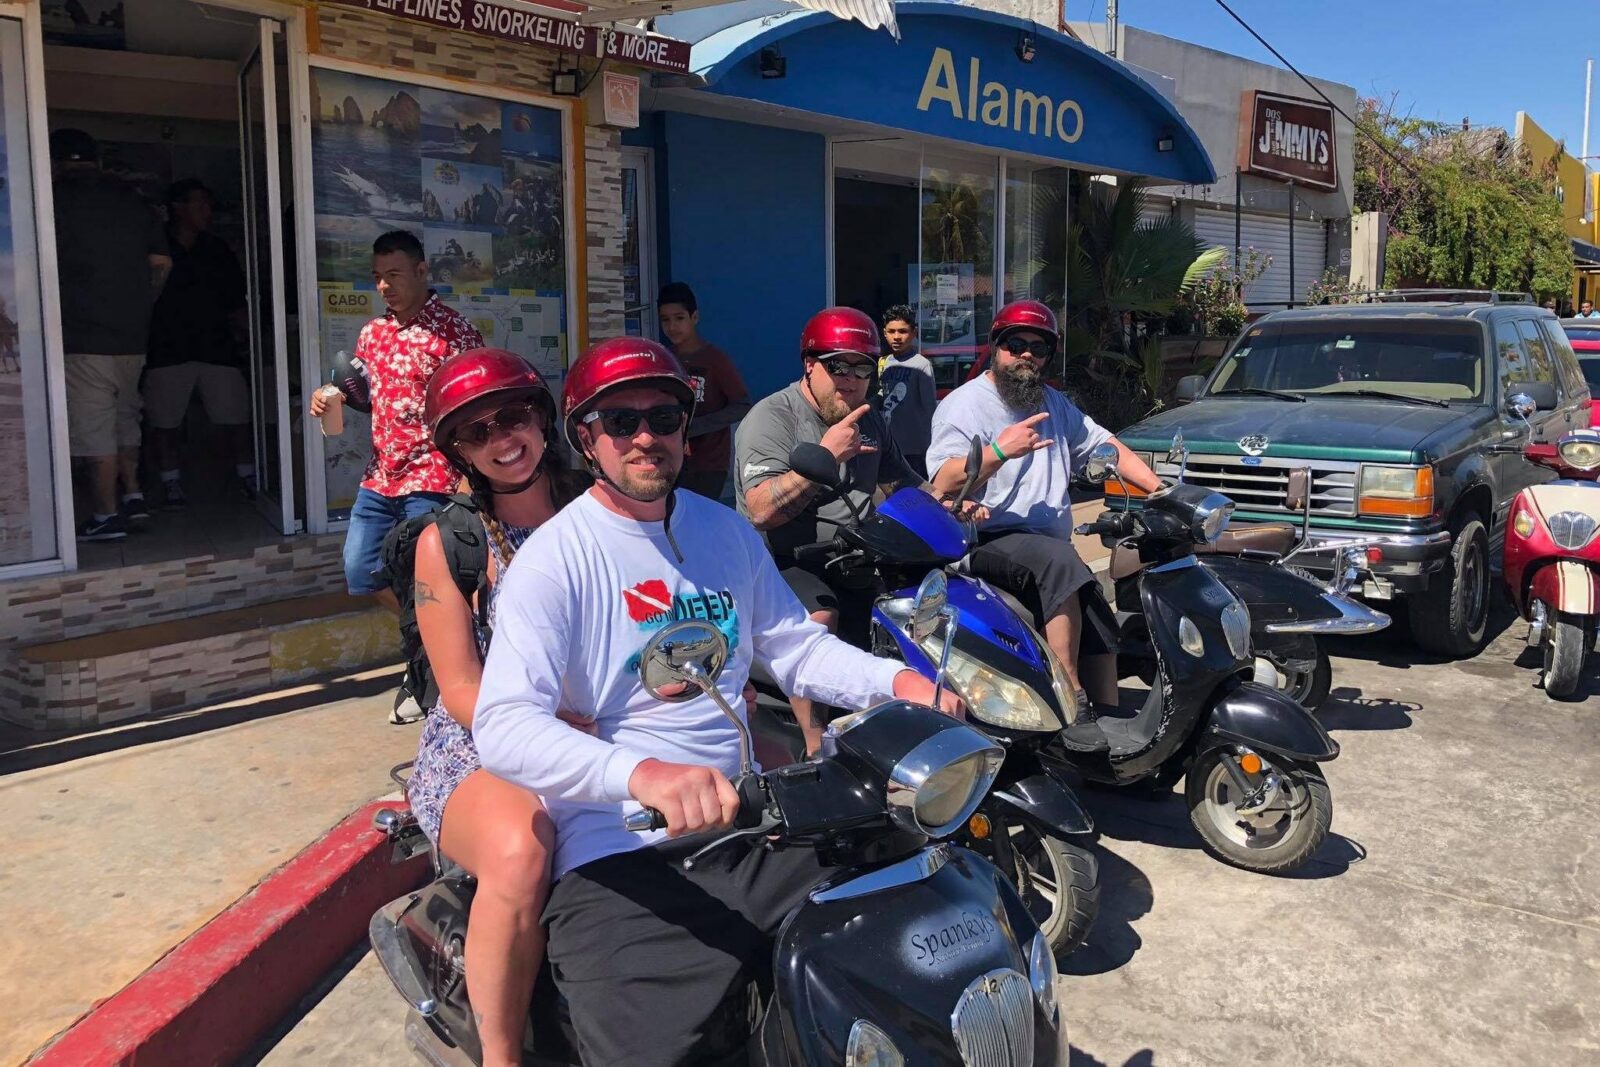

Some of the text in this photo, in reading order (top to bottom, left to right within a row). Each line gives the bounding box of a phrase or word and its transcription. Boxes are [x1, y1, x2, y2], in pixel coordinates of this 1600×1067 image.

[471, 3, 585, 50] SNORKELING
[606, 31, 617, 53] &
[916, 47, 1084, 144] Alamo
[1265, 107, 1281, 121] DOS
[328, 293, 368, 306] CABO
[645, 611, 662, 624] GO
[672, 590, 734, 622] DEEP
[911, 911, 995, 966] Spanky's
